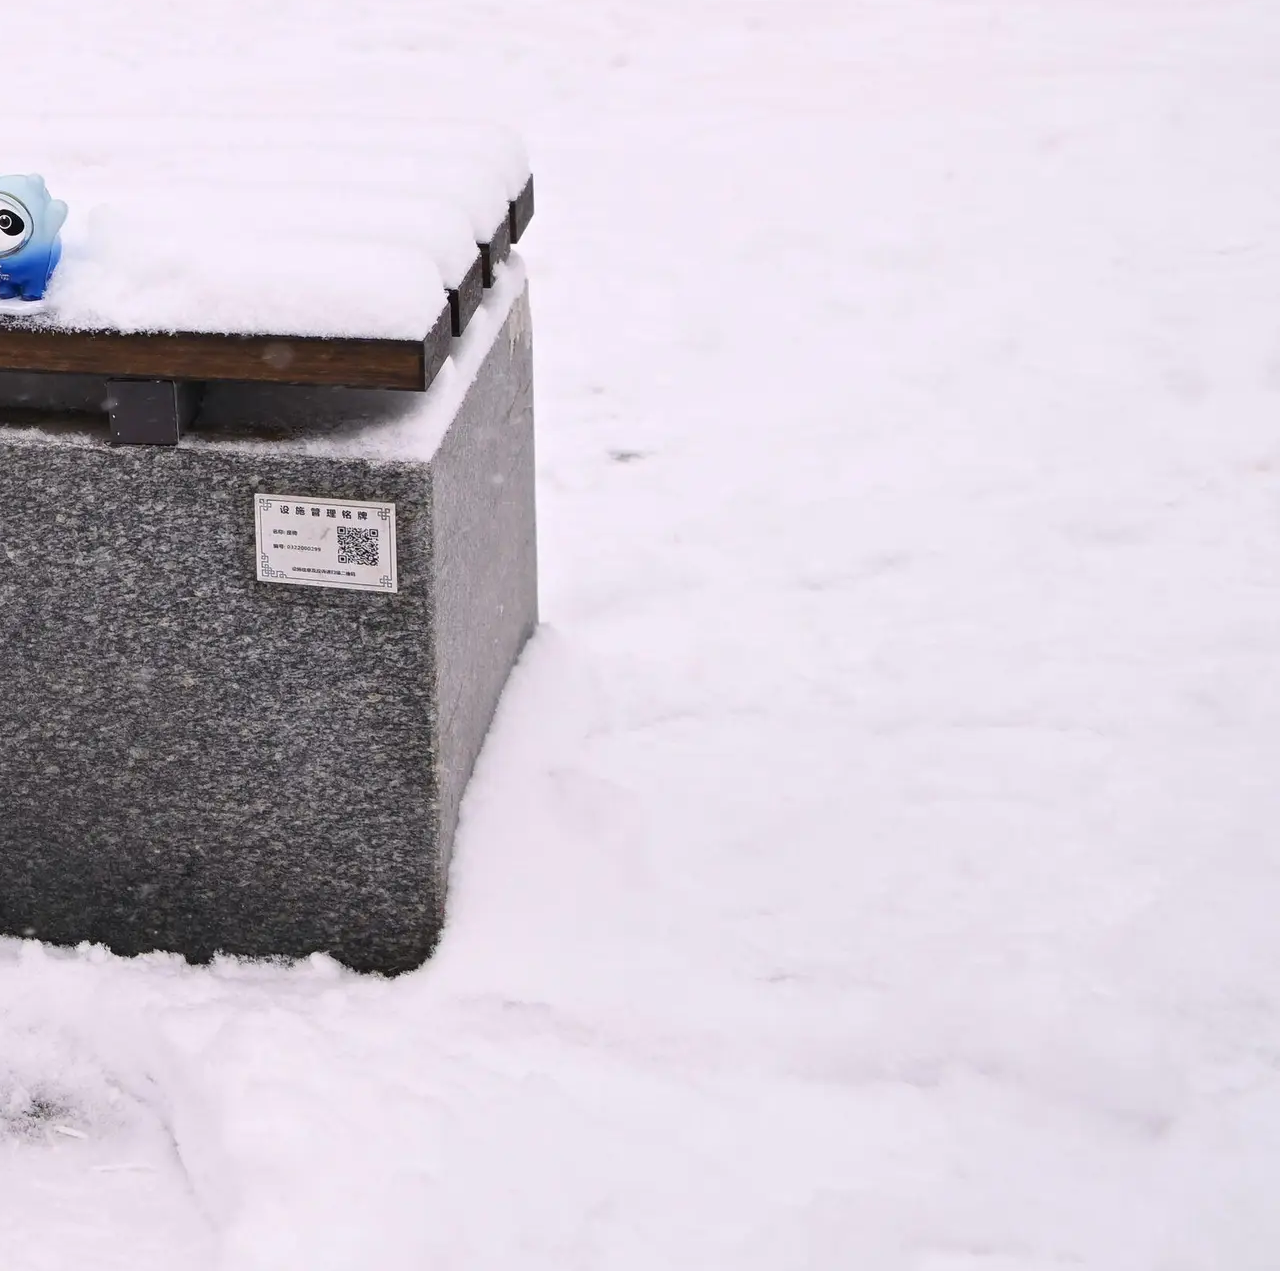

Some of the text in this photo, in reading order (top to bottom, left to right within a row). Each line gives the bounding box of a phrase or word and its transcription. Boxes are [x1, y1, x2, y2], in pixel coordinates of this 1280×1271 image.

[280, 505, 368, 520] 设施管理铭牌
